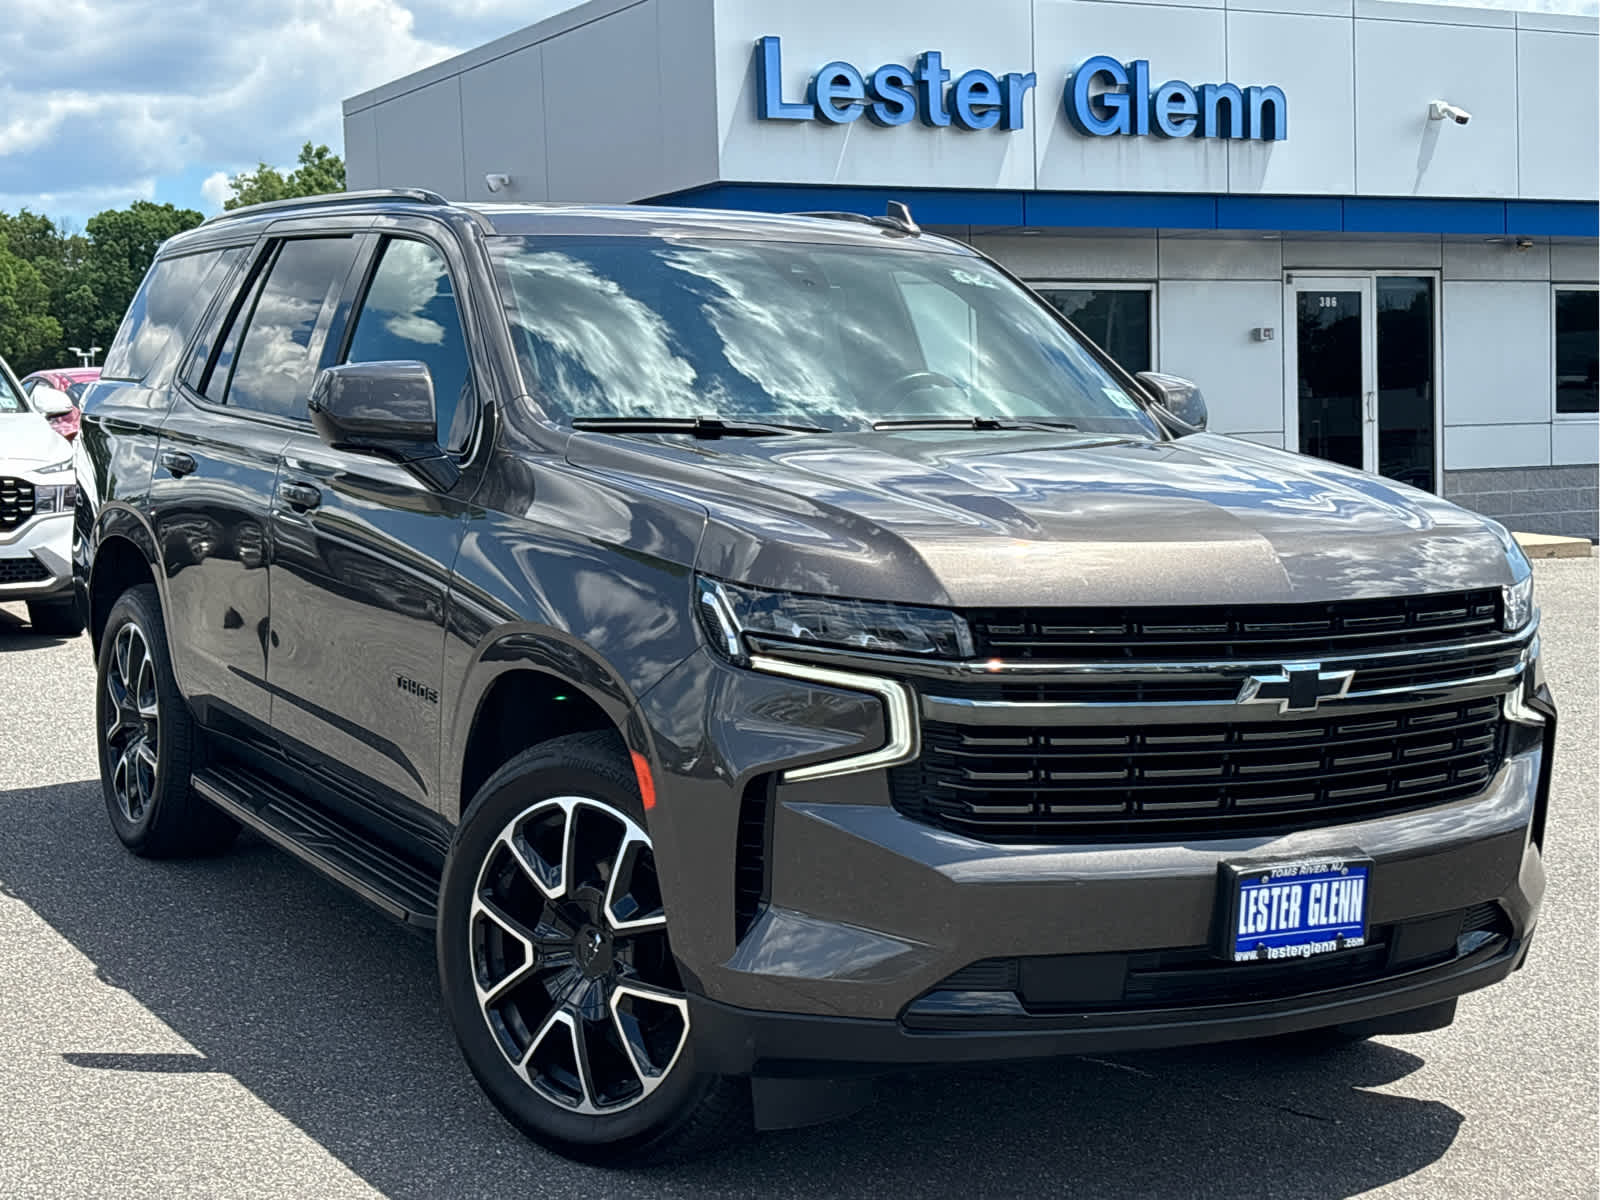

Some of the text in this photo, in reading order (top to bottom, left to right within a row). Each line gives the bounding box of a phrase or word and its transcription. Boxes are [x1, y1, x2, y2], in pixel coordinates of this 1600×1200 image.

[756, 36, 1288, 142] Lester Glenn
[1319, 296, 1337, 308] 386
[396, 673, 439, 704] TAHOE
[1271, 868, 1298, 879] TOMS
[1238, 879, 1364, 934] LESTER GLENN
